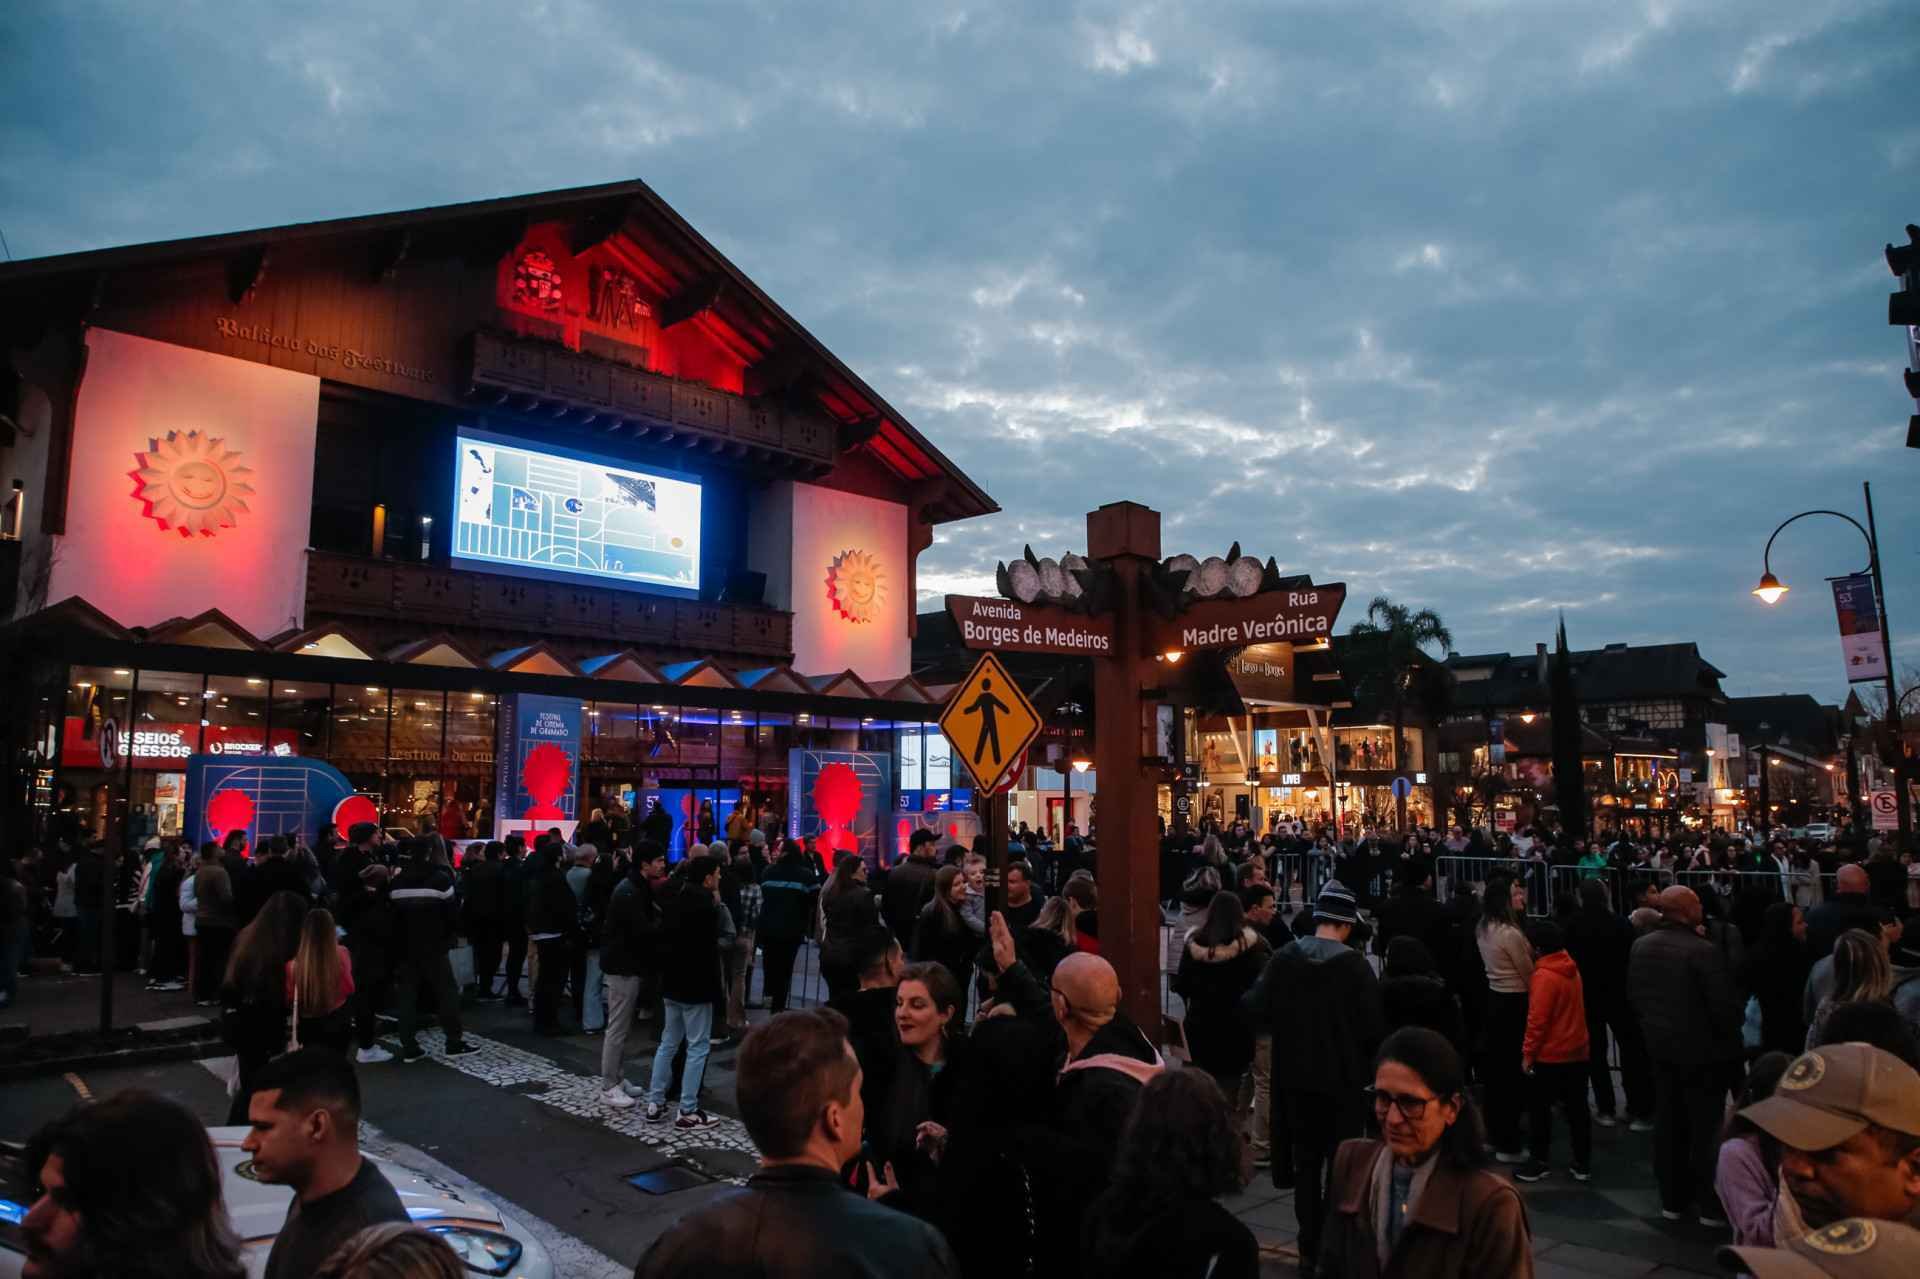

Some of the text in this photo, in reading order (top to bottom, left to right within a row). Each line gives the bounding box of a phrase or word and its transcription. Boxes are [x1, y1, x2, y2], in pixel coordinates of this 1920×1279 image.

[1288, 591, 1318, 607] Rua
[972, 601, 1021, 621] Avenida
[964, 621, 1109, 650] Borges de Medeiros
[1183, 614, 1328, 647] Madre Verônica
[118, 744, 192, 758] GRESSOS
